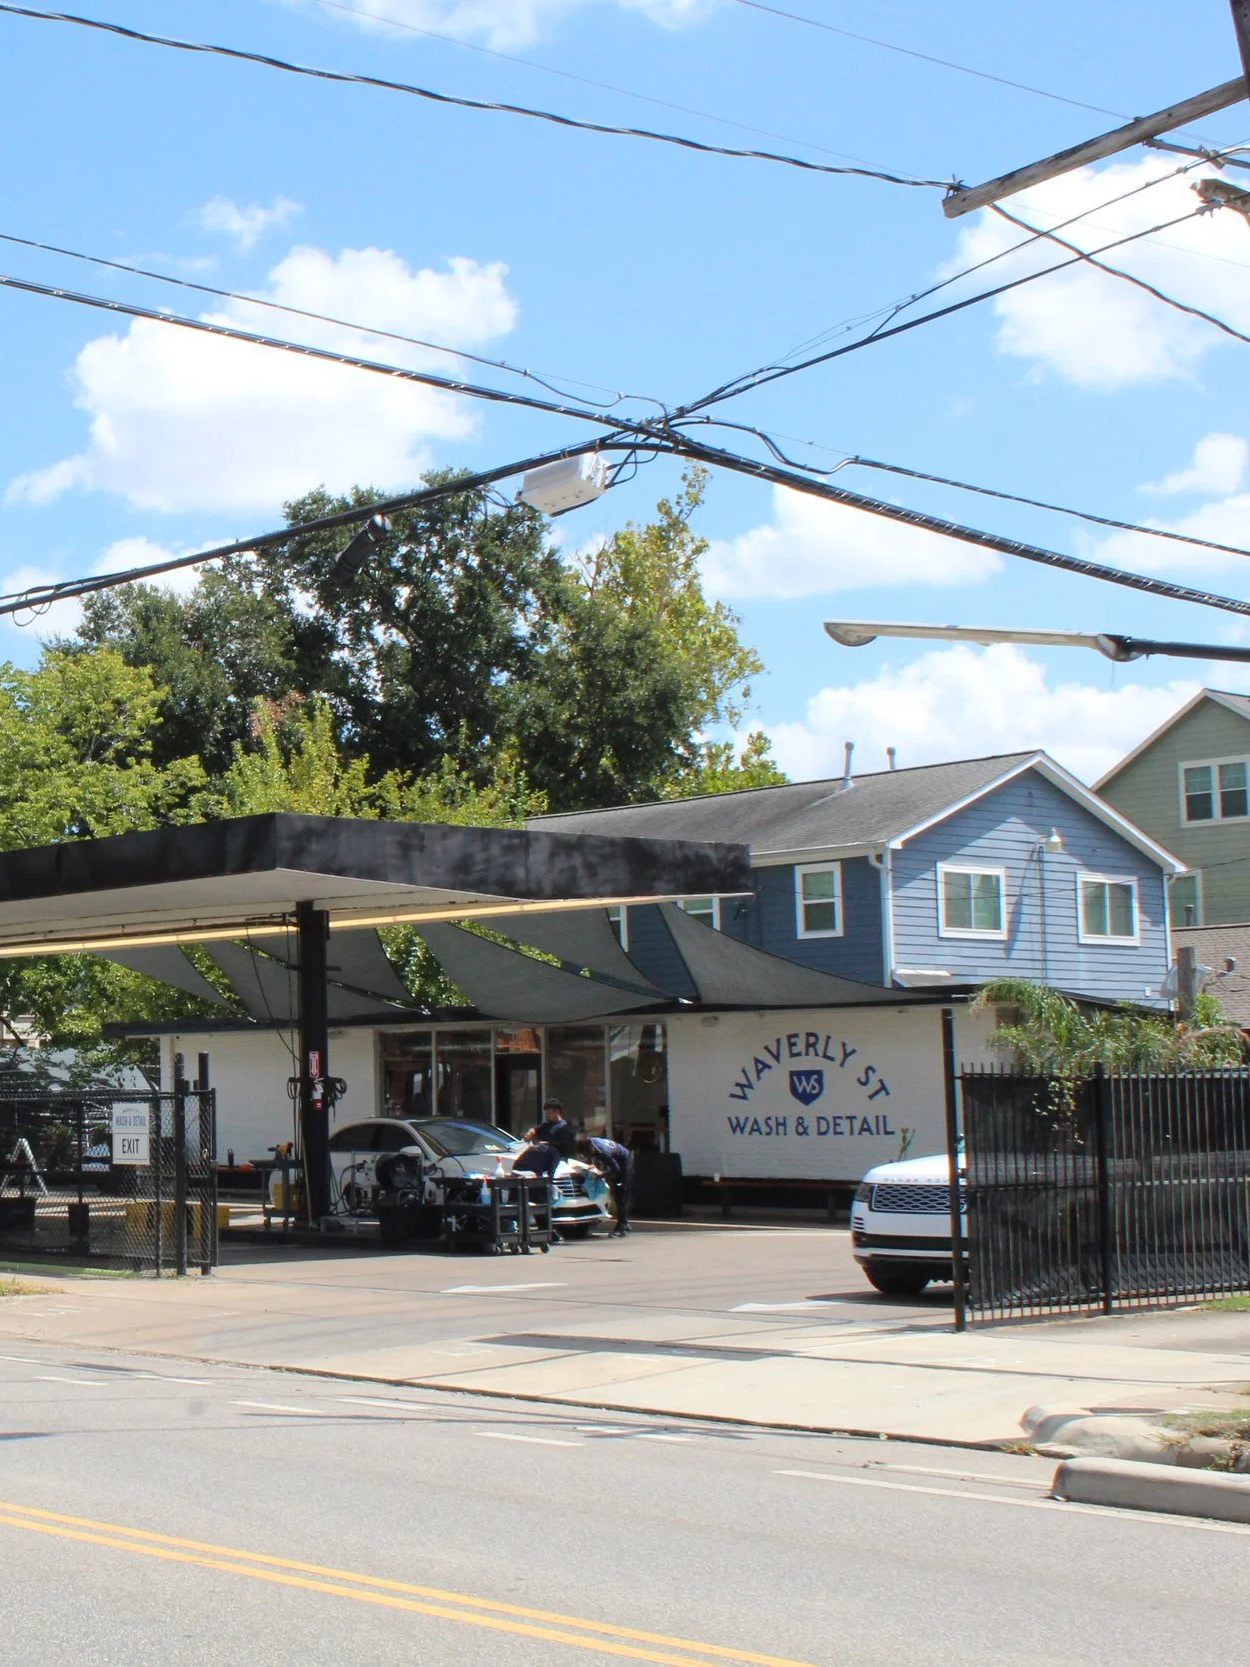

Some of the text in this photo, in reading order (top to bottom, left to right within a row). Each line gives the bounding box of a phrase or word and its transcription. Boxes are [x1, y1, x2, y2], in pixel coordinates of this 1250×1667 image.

[729, 1032, 891, 1101] WAVERLY ST
[791, 1074, 820, 1096] WS
[726, 1115, 896, 1136] WASH & DETAIL
[121, 1138, 140, 1154] EXIT
